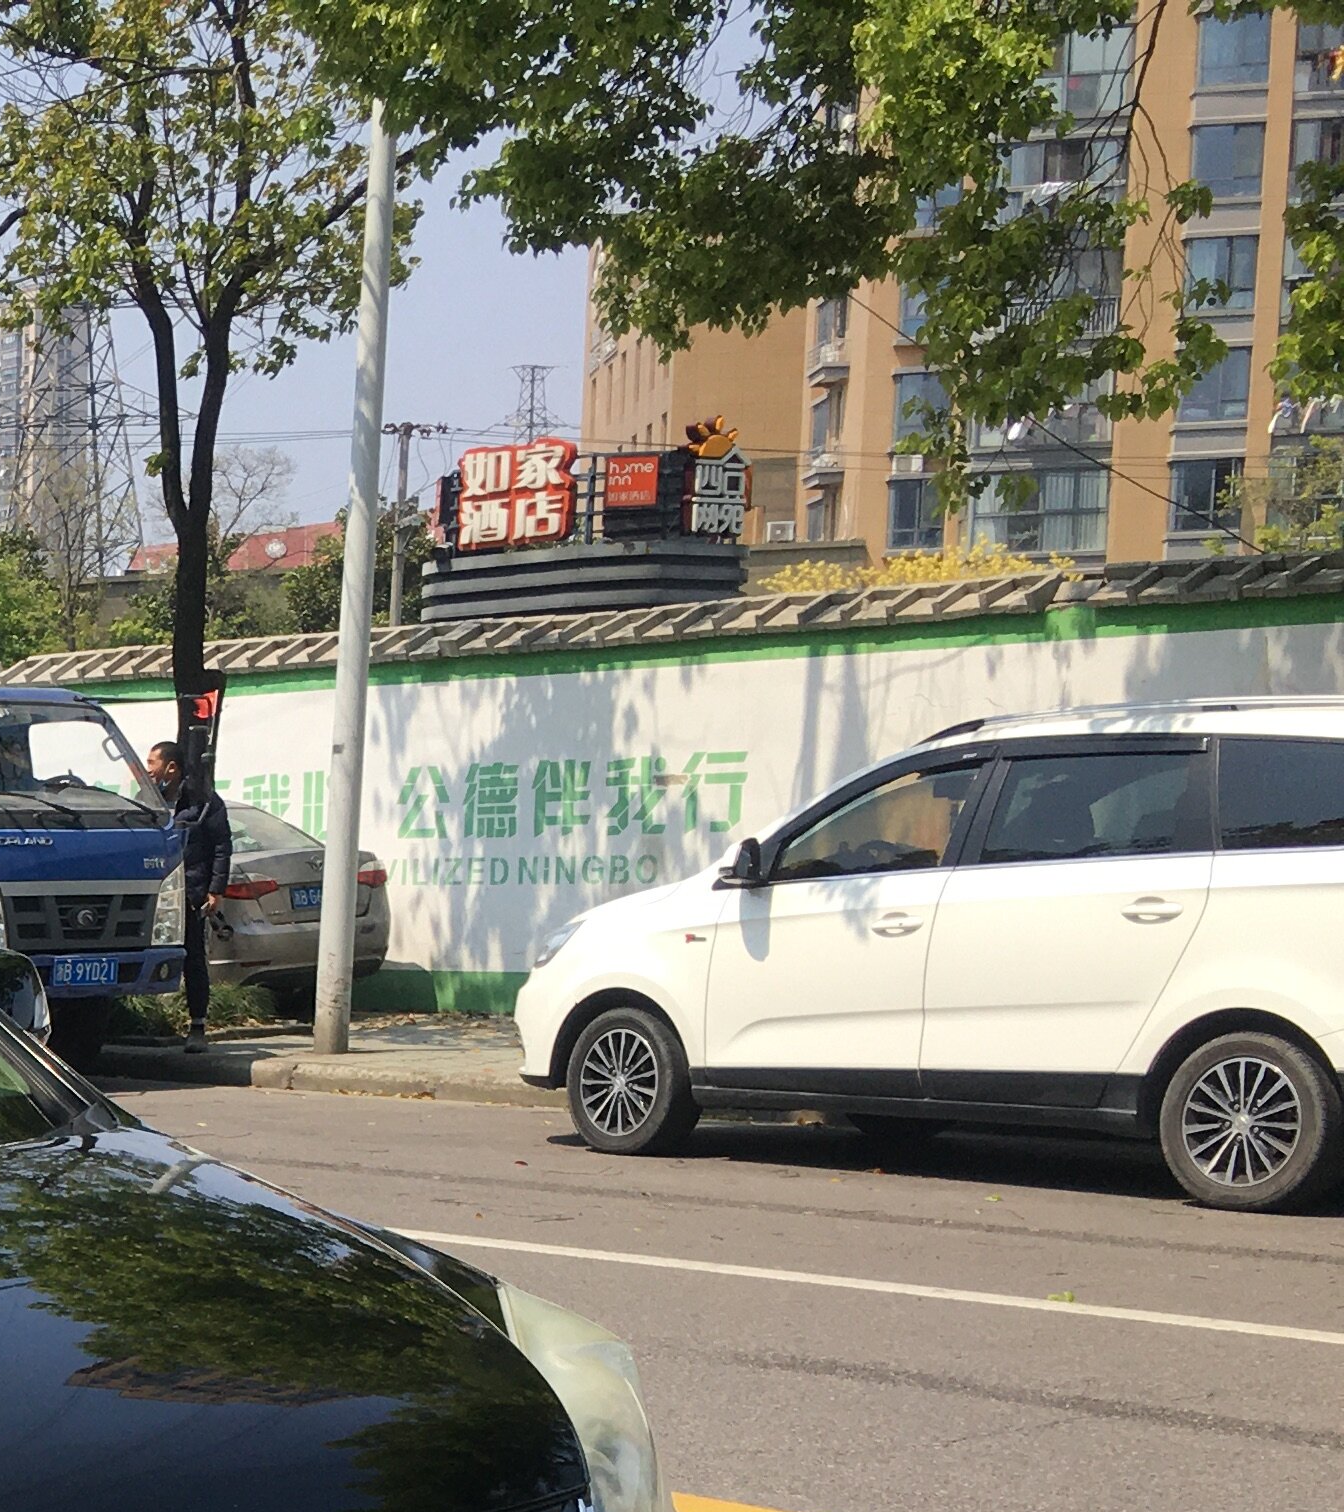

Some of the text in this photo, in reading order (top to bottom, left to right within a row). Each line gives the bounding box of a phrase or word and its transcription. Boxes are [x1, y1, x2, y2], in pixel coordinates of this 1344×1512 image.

[462, 444, 566, 498] 如家
[608, 475, 632, 486] inn
[609, 461, 655, 474] home
[459, 490, 563, 545] 酒店
[397, 752, 749, 840] 公德伴我行
[384, 854, 659, 887] VILIZED NINGBO
